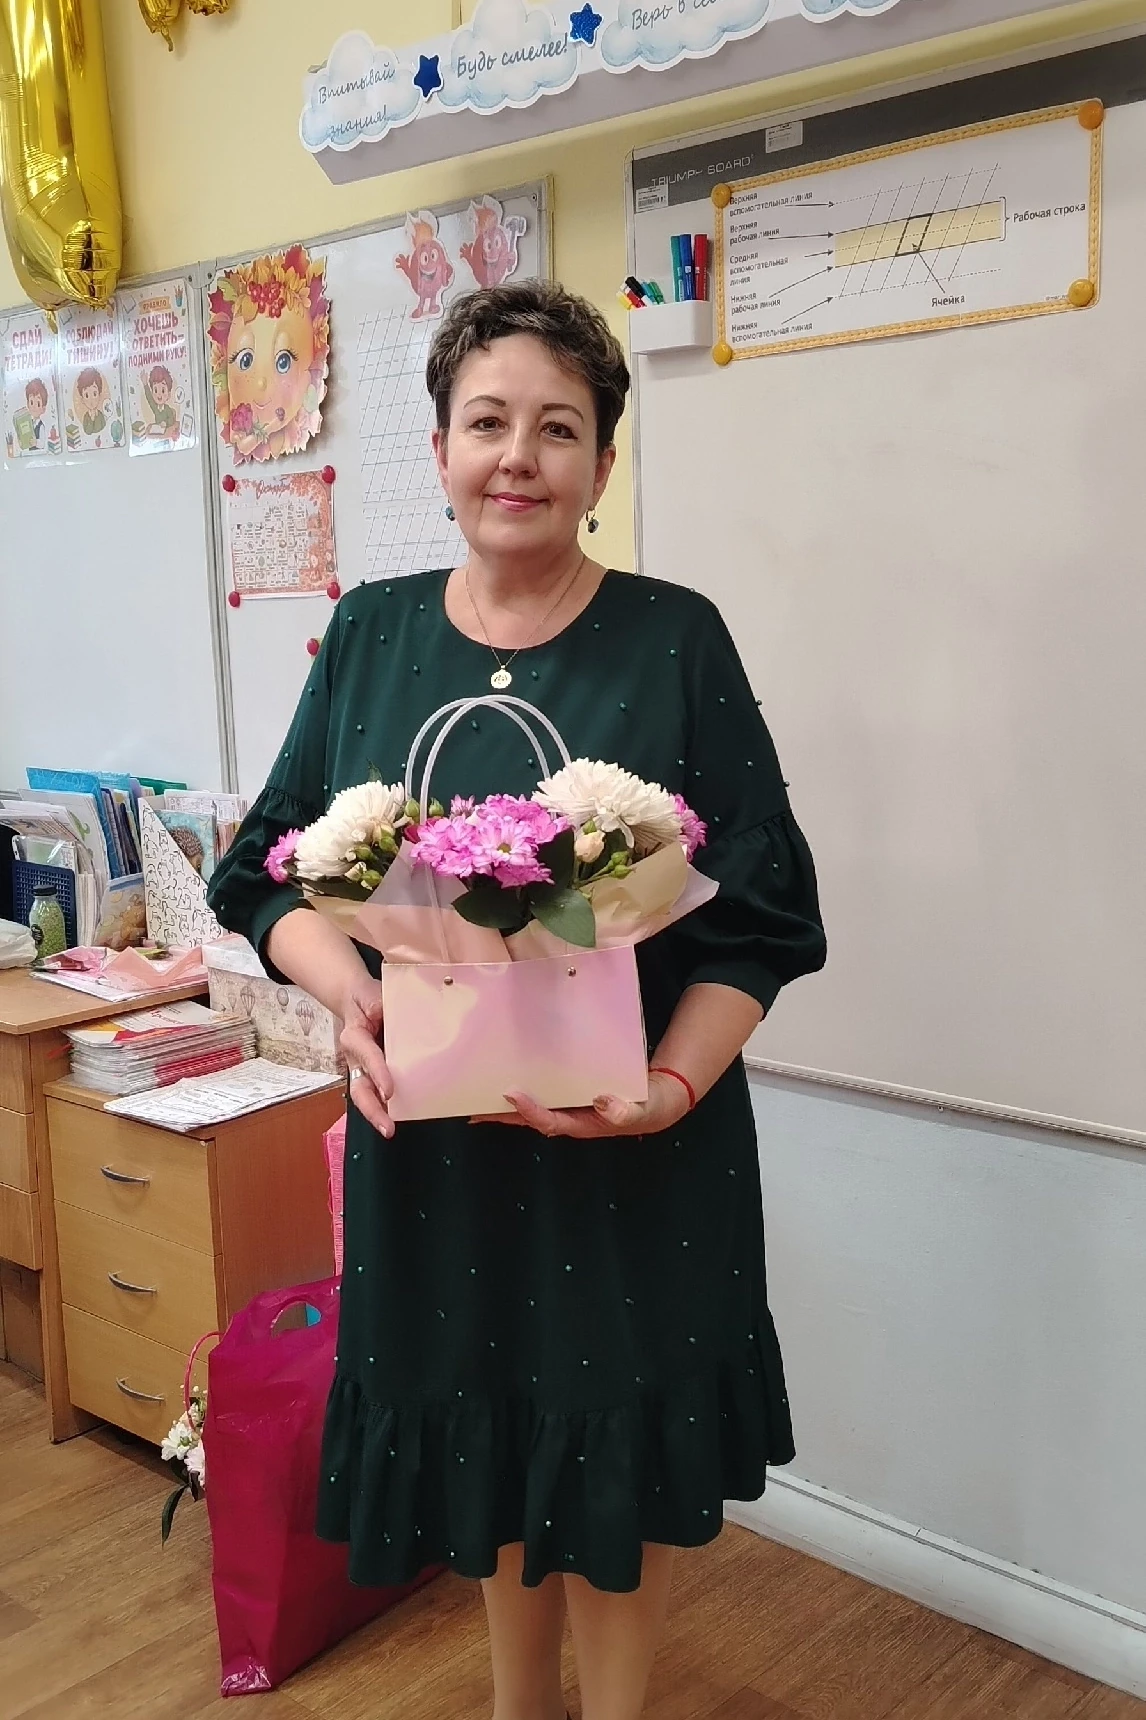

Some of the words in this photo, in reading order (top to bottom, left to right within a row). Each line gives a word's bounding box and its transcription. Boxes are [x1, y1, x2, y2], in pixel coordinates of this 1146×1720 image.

[632, 5, 673, 30] Верь
[456, 51, 496, 80] Будь
[501, 33, 568, 66] смелее!
[318, 62, 396, 104] Впитывай
[329, 105, 387, 142] знания!
[707, 156, 751, 175] BOARD
[1013, 208, 1051, 224] Рабочая
[1053, 202, 1086, 217] строка
[729, 233, 758, 247] рабочая
[758, 228, 780, 238] линия
[730, 221, 758, 234] Верхняя
[729, 252, 759, 265] Средняя
[729, 257, 789, 276] вспомогательная
[729, 276, 751, 287] линия
[731, 303, 759, 317] рабочая
[759, 299, 781, 310] линия
[931, 294, 965, 308] Ячейка
[65, 320, 114, 344] СОБЛЮДАЙ
[133, 311, 179, 335] ХОЧЕШЬ
[731, 321, 758, 333] Нижняя
[731, 326, 789, 344] вспомогательная
[790, 322, 813, 334] линия
[12, 324, 43, 351] СДАЙ
[4, 348, 52, 372] ТЕТРАДИ!
[66, 341, 114, 365] ТИШИНУ!
[165, 345, 187, 361] РУКУ!
